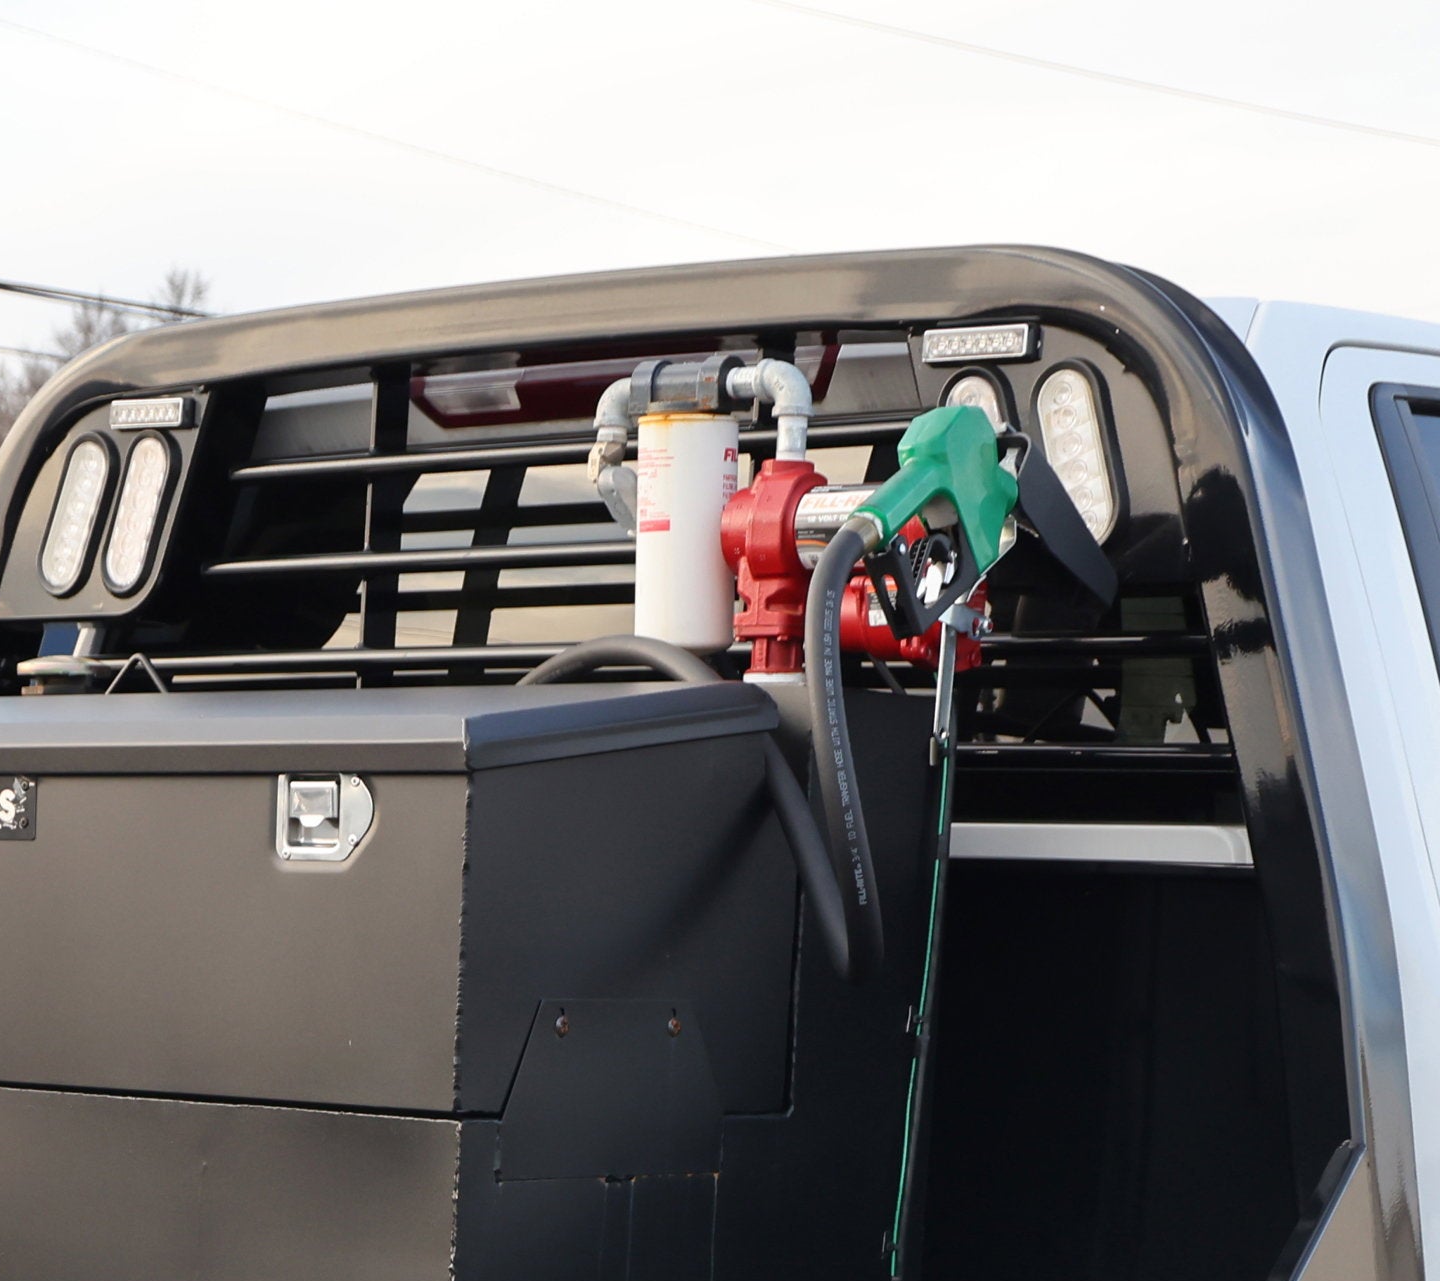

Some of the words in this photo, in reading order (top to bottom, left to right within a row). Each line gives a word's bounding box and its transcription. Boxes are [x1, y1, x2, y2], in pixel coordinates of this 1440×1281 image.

[818, 514, 838, 523] VOLT
[825, 679, 835, 697] WIRE
[827, 698, 839, 725] STATIC
[830, 726, 841, 746] WITH
[833, 748, 845, 768] HOSE
[837, 770, 851, 807] TRANSFER
[844, 809, 856, 829] FUEL
